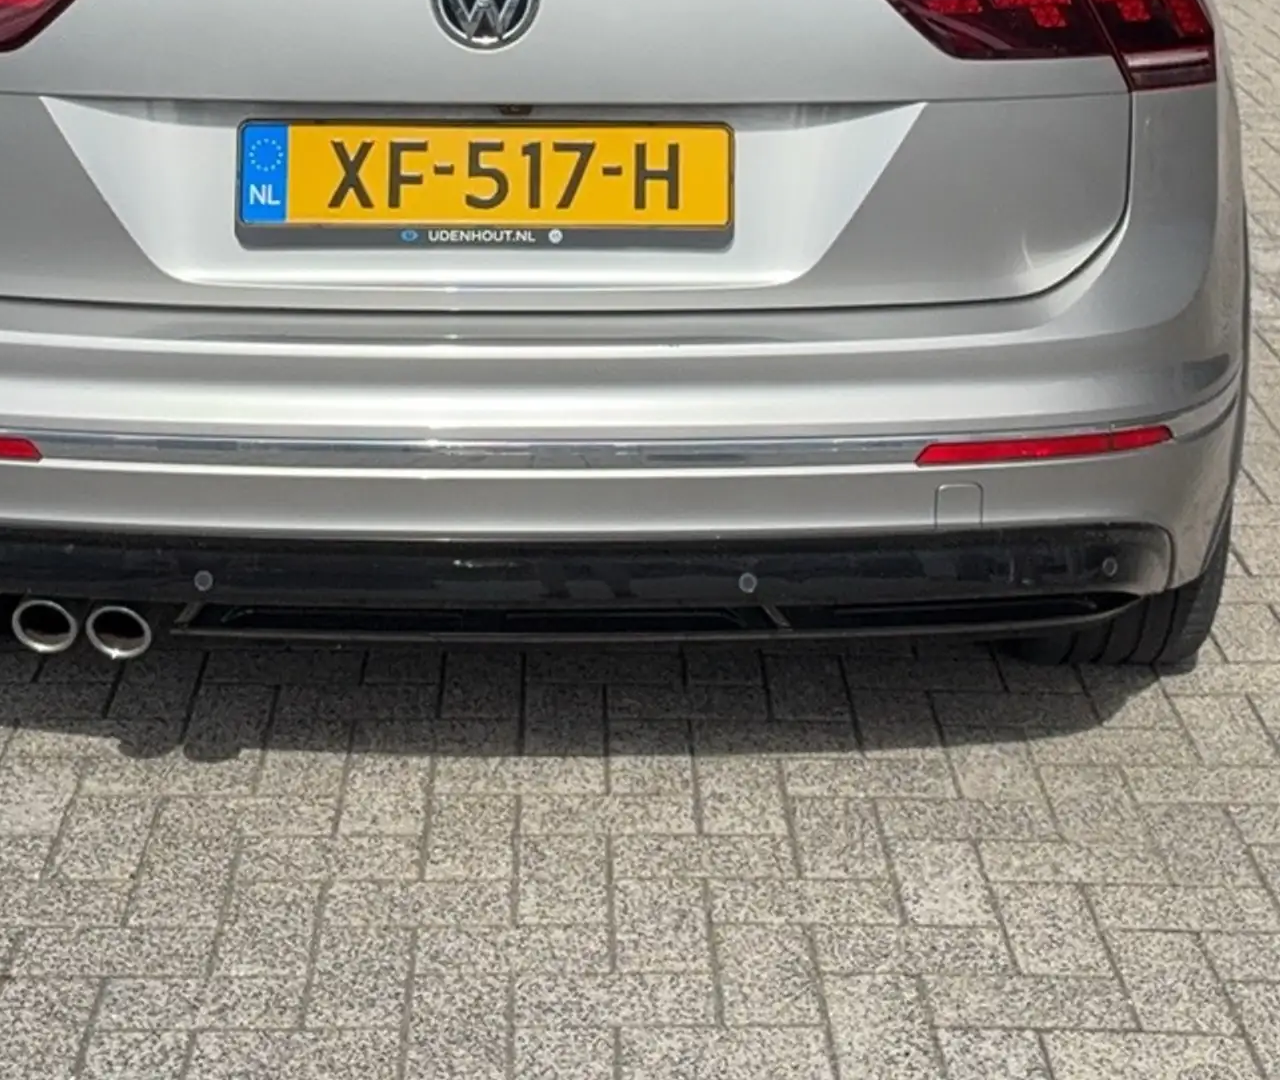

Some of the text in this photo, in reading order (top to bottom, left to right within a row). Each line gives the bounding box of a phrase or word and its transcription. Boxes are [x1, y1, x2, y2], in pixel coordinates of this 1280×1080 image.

[327, 139, 681, 211] XF-517-H
[249, 183, 281, 205] NL
[427, 229, 536, 243] UDENHOUT.NL
